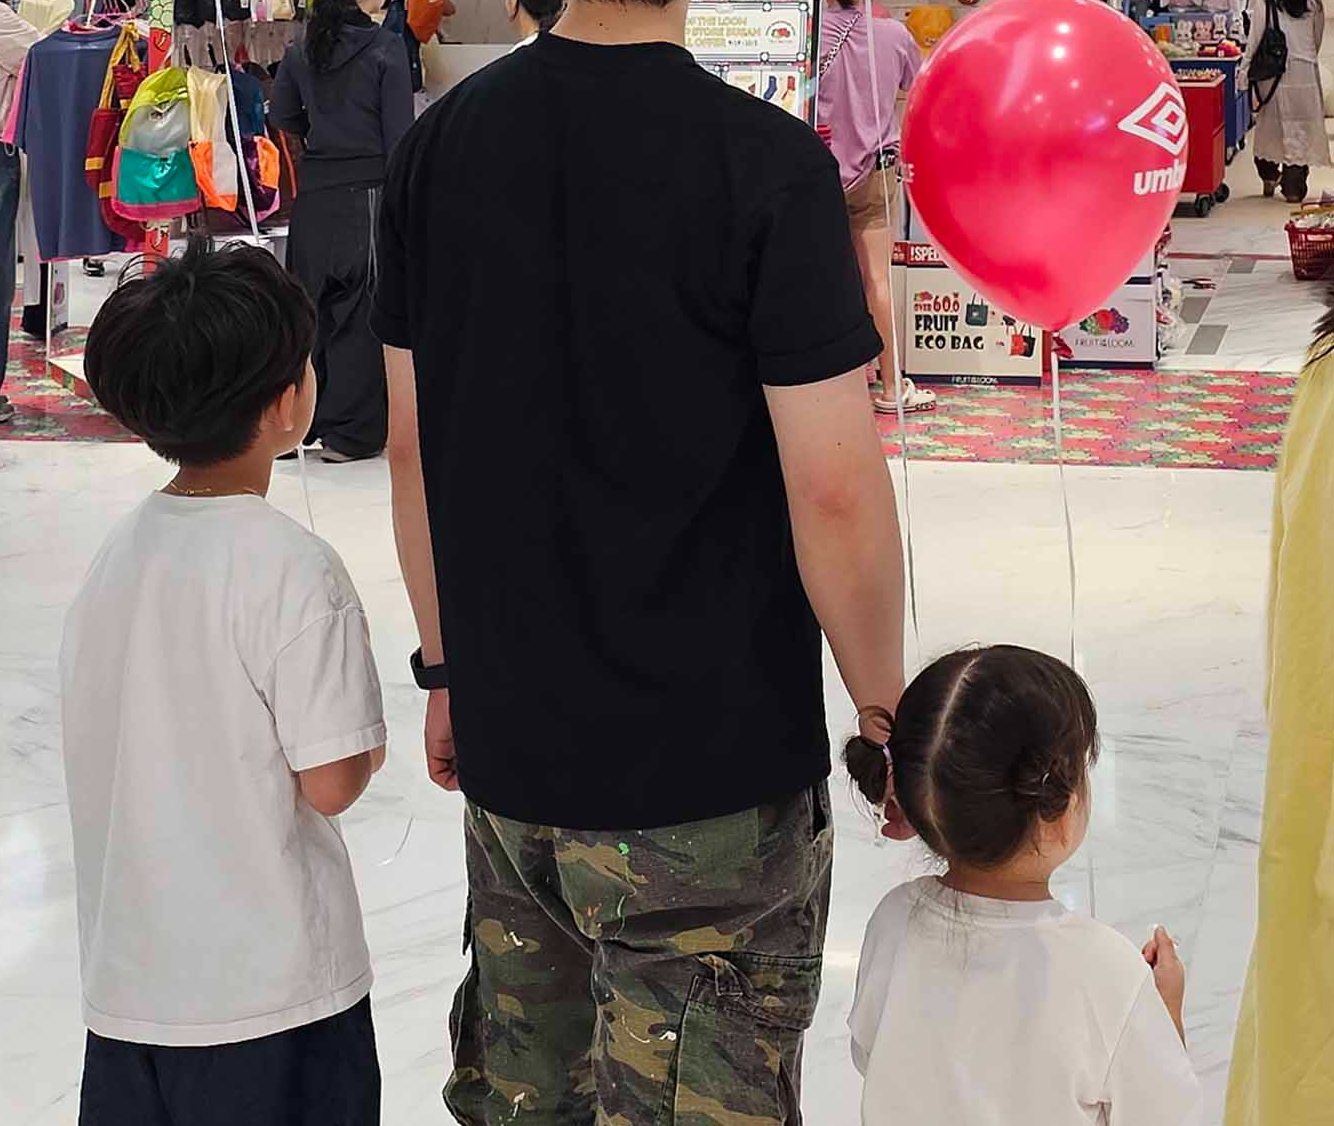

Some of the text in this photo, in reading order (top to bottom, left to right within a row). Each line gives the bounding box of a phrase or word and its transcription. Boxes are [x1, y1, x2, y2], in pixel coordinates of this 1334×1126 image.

[915, 314, 959, 331] FRUIT
[915, 335, 985, 349] ECO BAG
[1075, 339, 1098, 347] FRUIT
